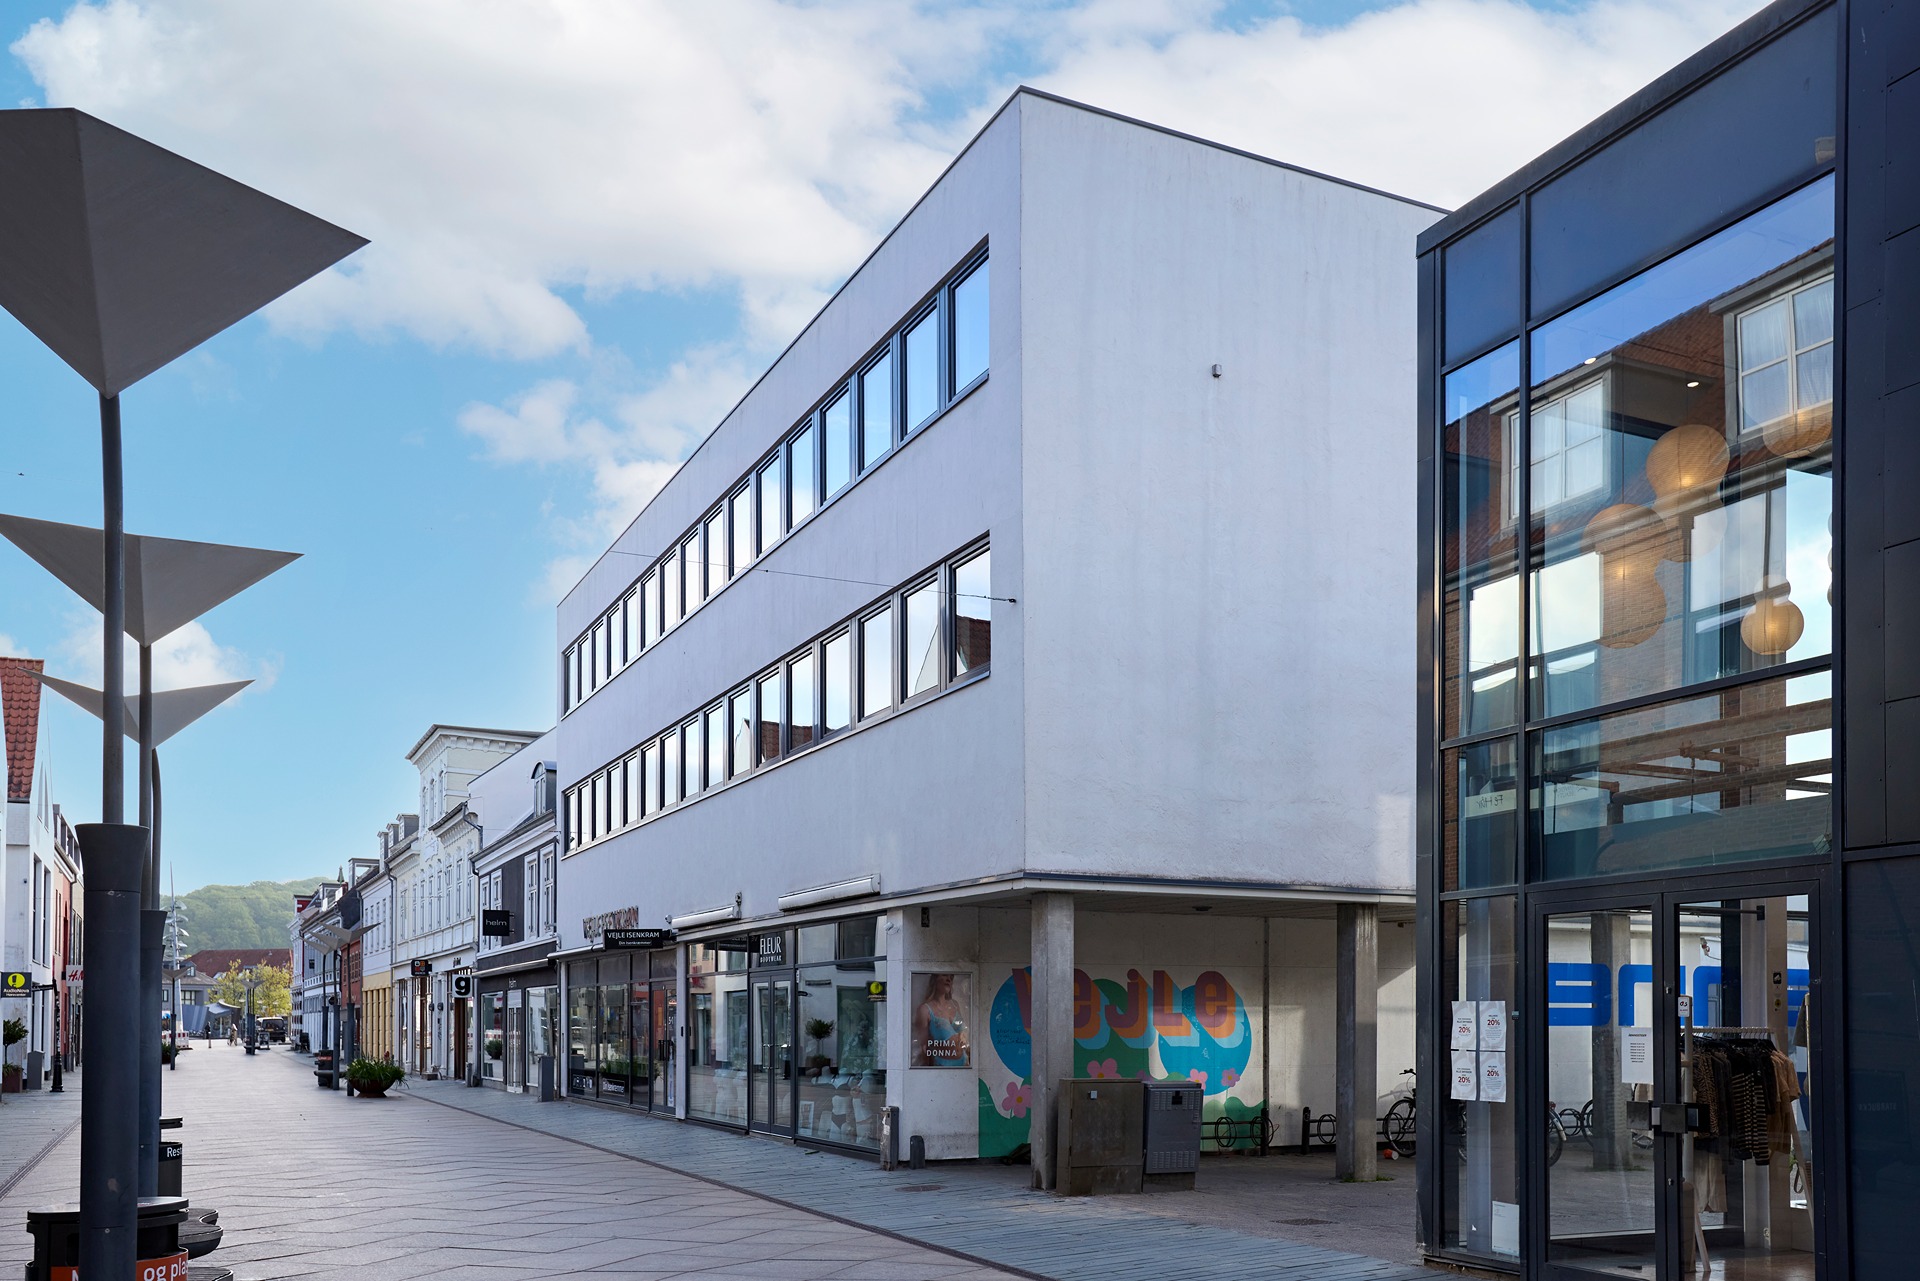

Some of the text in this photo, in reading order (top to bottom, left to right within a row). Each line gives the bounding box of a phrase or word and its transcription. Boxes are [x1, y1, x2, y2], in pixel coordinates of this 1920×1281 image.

[485, 918, 508, 926] helm
[607, 931, 660, 940] VEJLE ISENKRAM
[760, 936, 782, 955] FLEUR
[454, 976, 471, 996] g
[1458, 1026, 1471, 1034] 20%
[927, 1039, 957, 1048] PRIMA
[926, 1049, 958, 1057] DONNA
[1458, 1076, 1471, 1084] 20%
[144, 1264, 166, 1281] og
